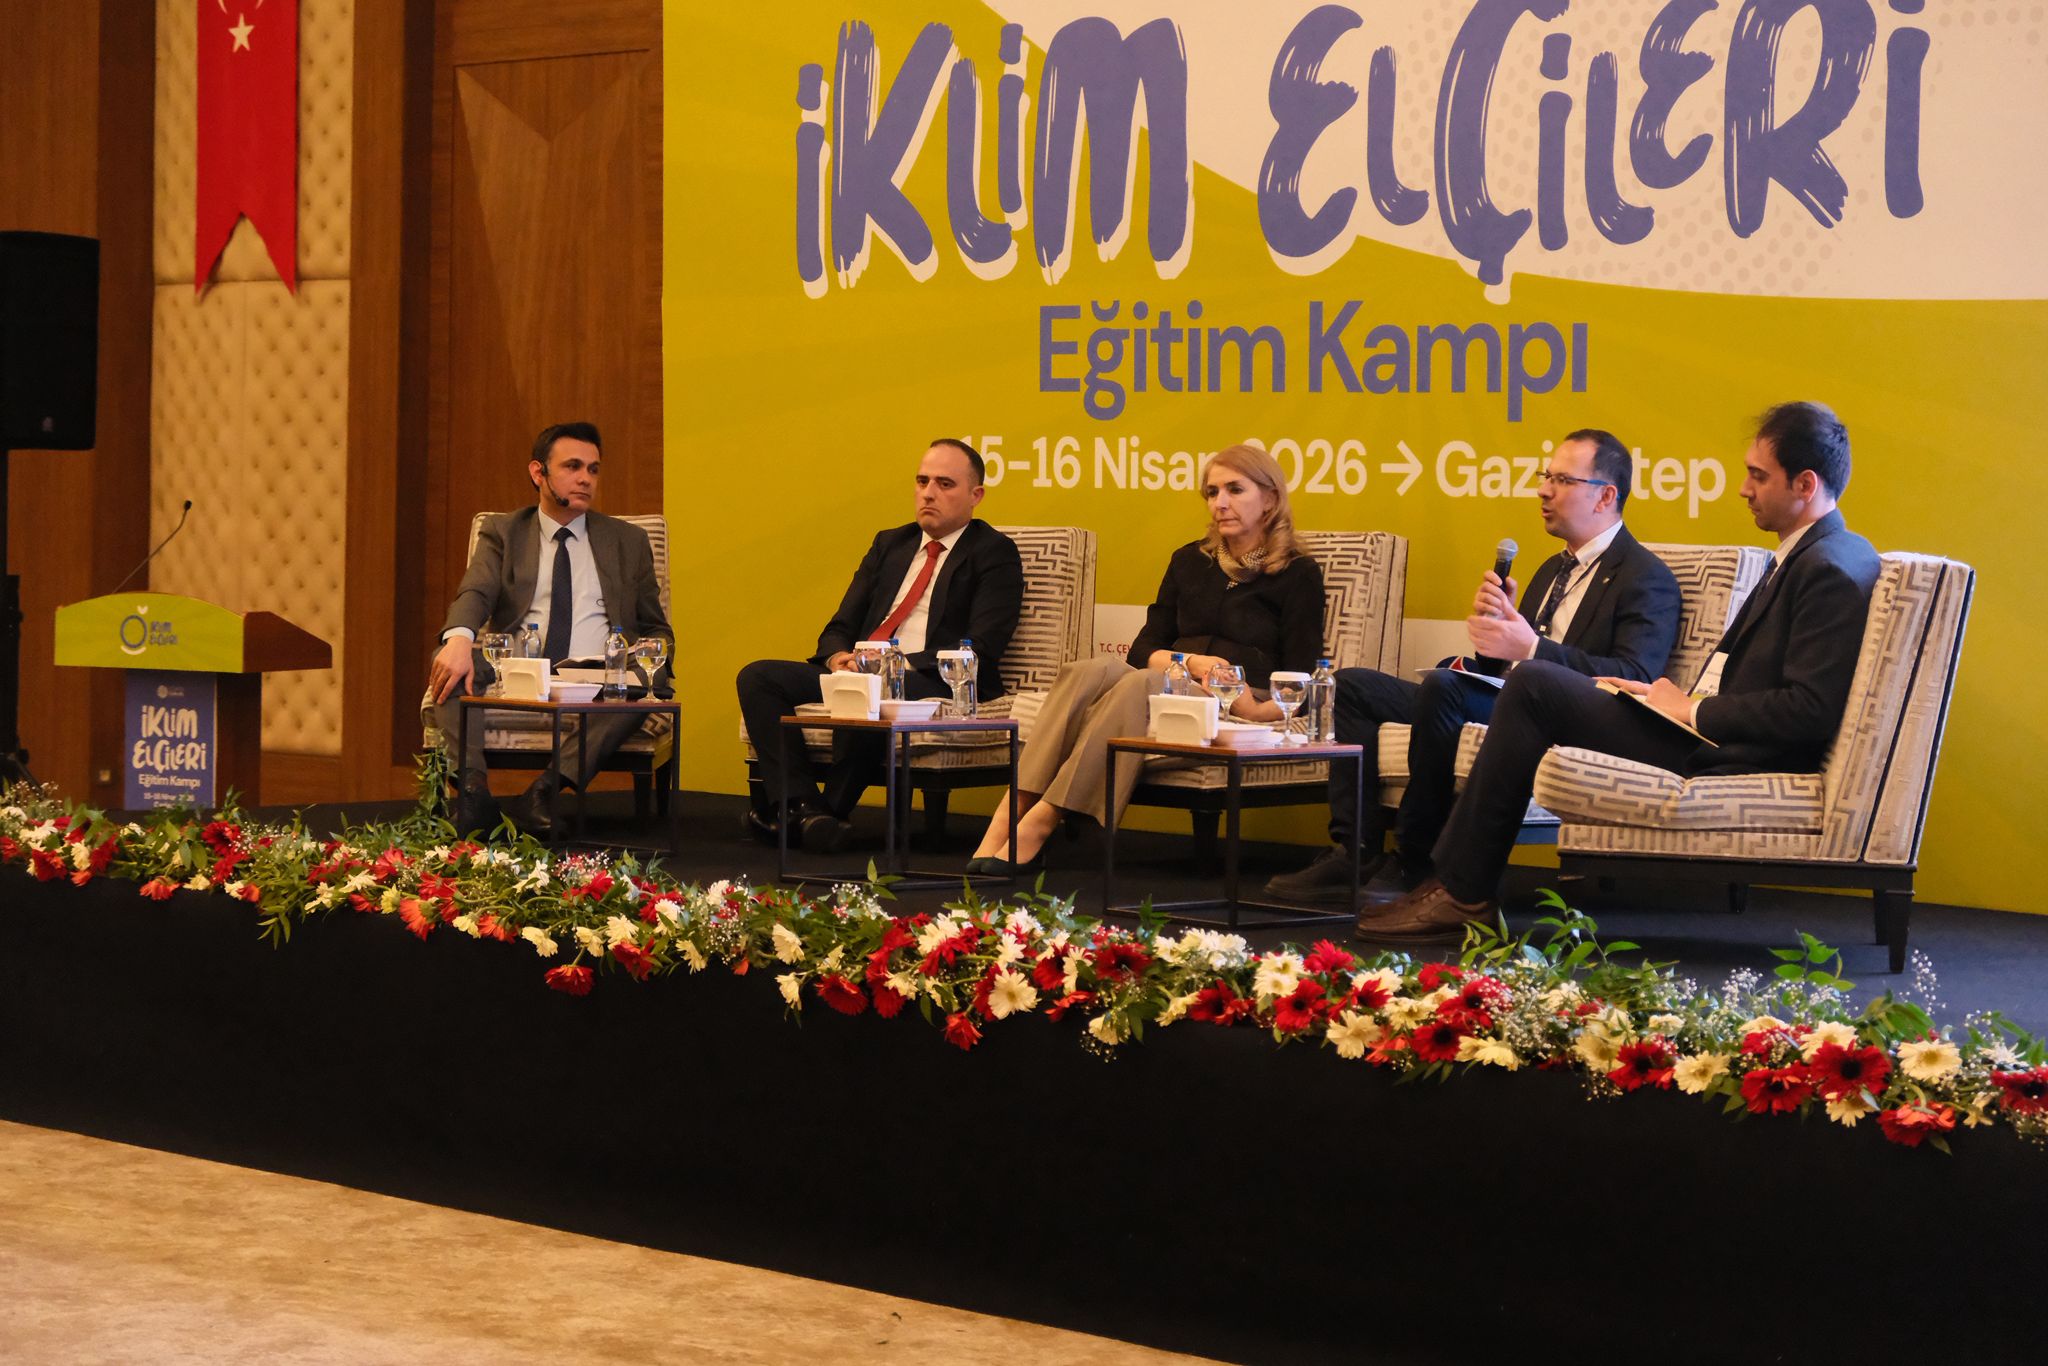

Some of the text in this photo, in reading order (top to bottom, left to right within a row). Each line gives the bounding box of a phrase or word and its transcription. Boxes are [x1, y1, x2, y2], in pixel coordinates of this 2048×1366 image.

[1039, 300, 1588, 422] Eğitim Kampı
[959, 435, 1081, 488] 5-16
[1243, 438, 1367, 496] 026
[1436, 440, 1726, 519] Gazitep
[1100, 643, 1115, 653] T.C.
